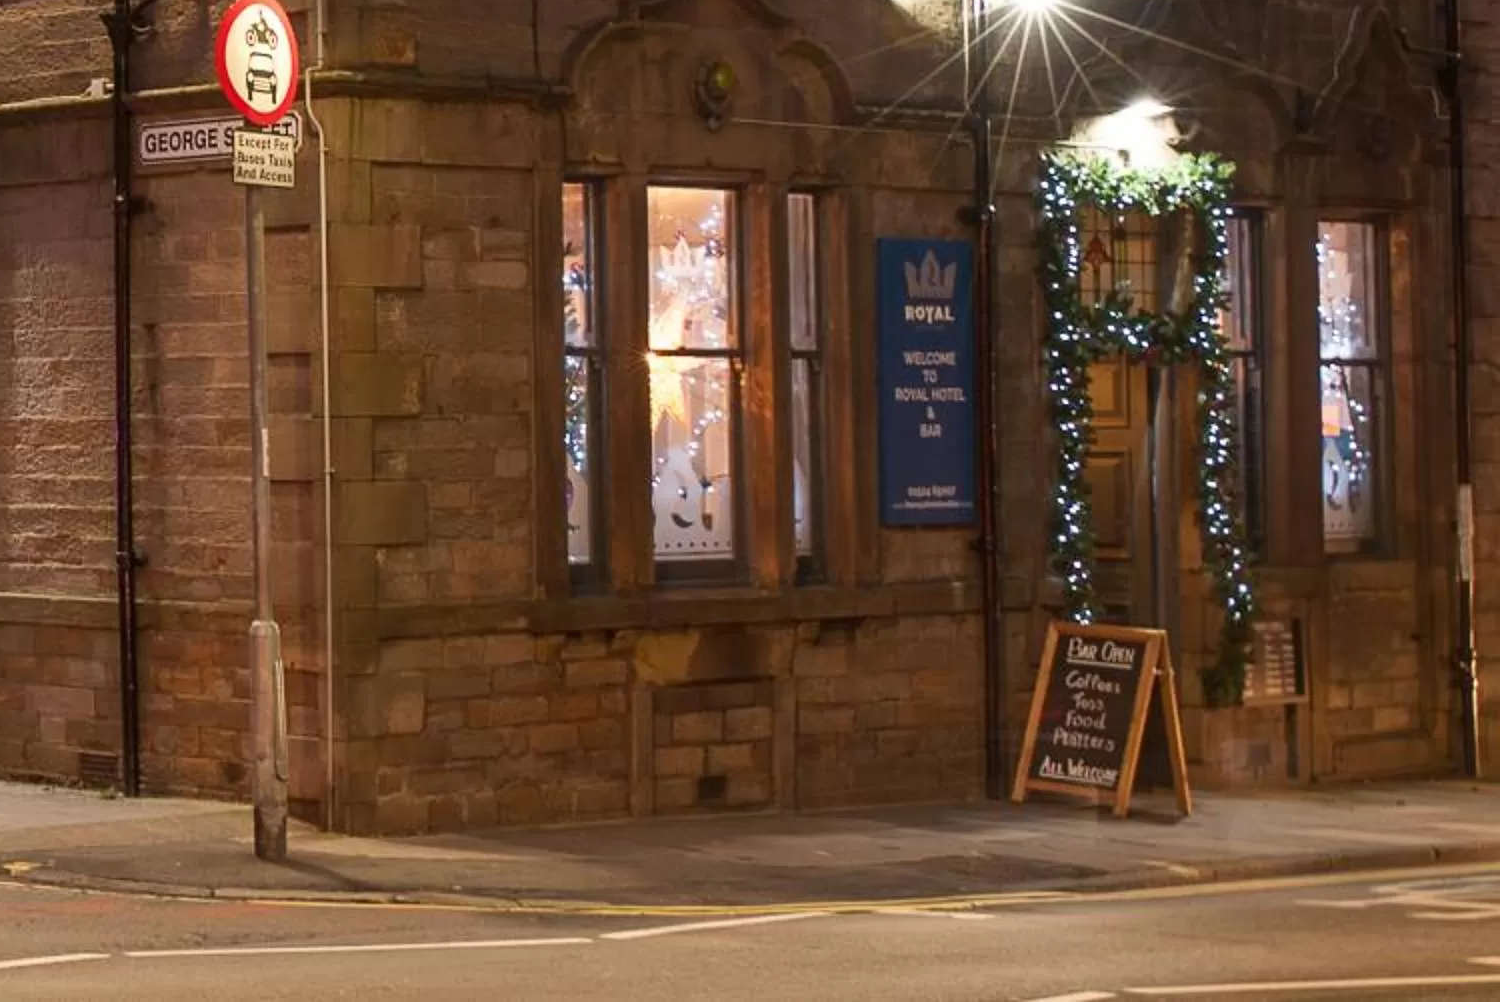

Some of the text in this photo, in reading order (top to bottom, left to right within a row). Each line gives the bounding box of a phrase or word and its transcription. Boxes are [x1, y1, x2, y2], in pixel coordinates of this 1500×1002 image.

[145, 127, 218, 154] GEORGE
[238, 133, 289, 151] Except For
[237, 151, 293, 169] Buses Taxis
[235, 166, 293, 182] And Access
[904, 305, 956, 324] ROYAL
[903, 351, 956, 366] WELCOME
[922, 369, 938, 383] TO
[894, 386, 966, 402] ROYAL HOTEL
[919, 423, 942, 439] BAR
